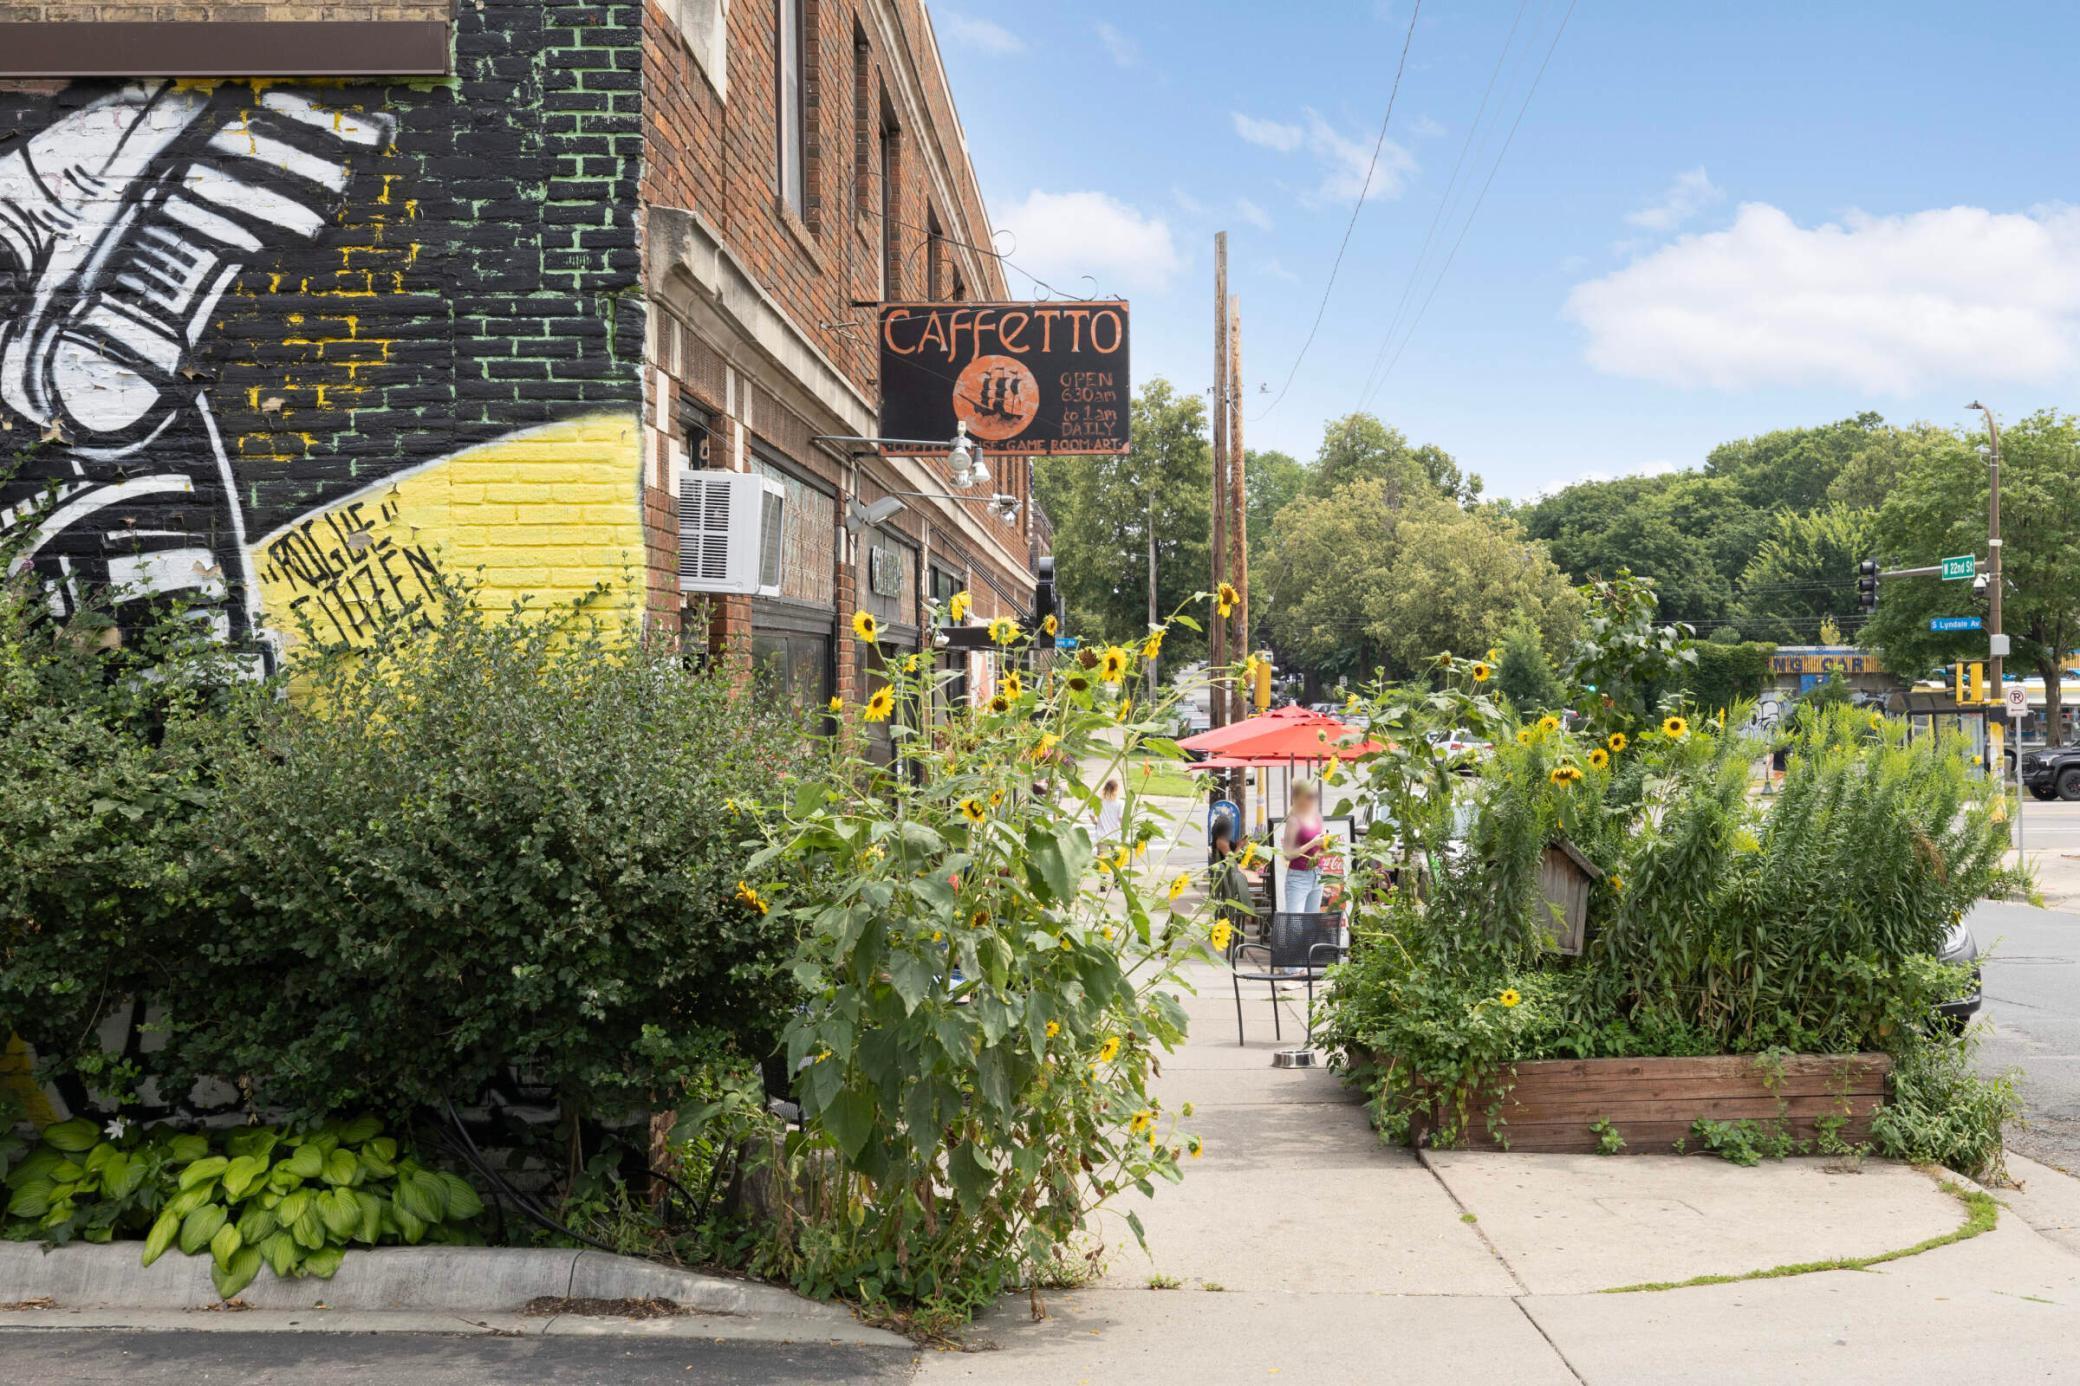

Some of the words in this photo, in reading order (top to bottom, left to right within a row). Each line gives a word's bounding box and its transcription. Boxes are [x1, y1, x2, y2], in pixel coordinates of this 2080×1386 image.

[1060, 371, 1113, 387] OPEN
[1063, 407, 1079, 421] to
[1061, 421, 1116, 437] DAILY
[1006, 439, 1046, 451] GAME
[1051, 438, 1090, 451] ROOM
[1093, 438, 1120, 450] ART
[1950, 562, 1965, 575] 22nd
[1966, 561, 1973, 573] St
